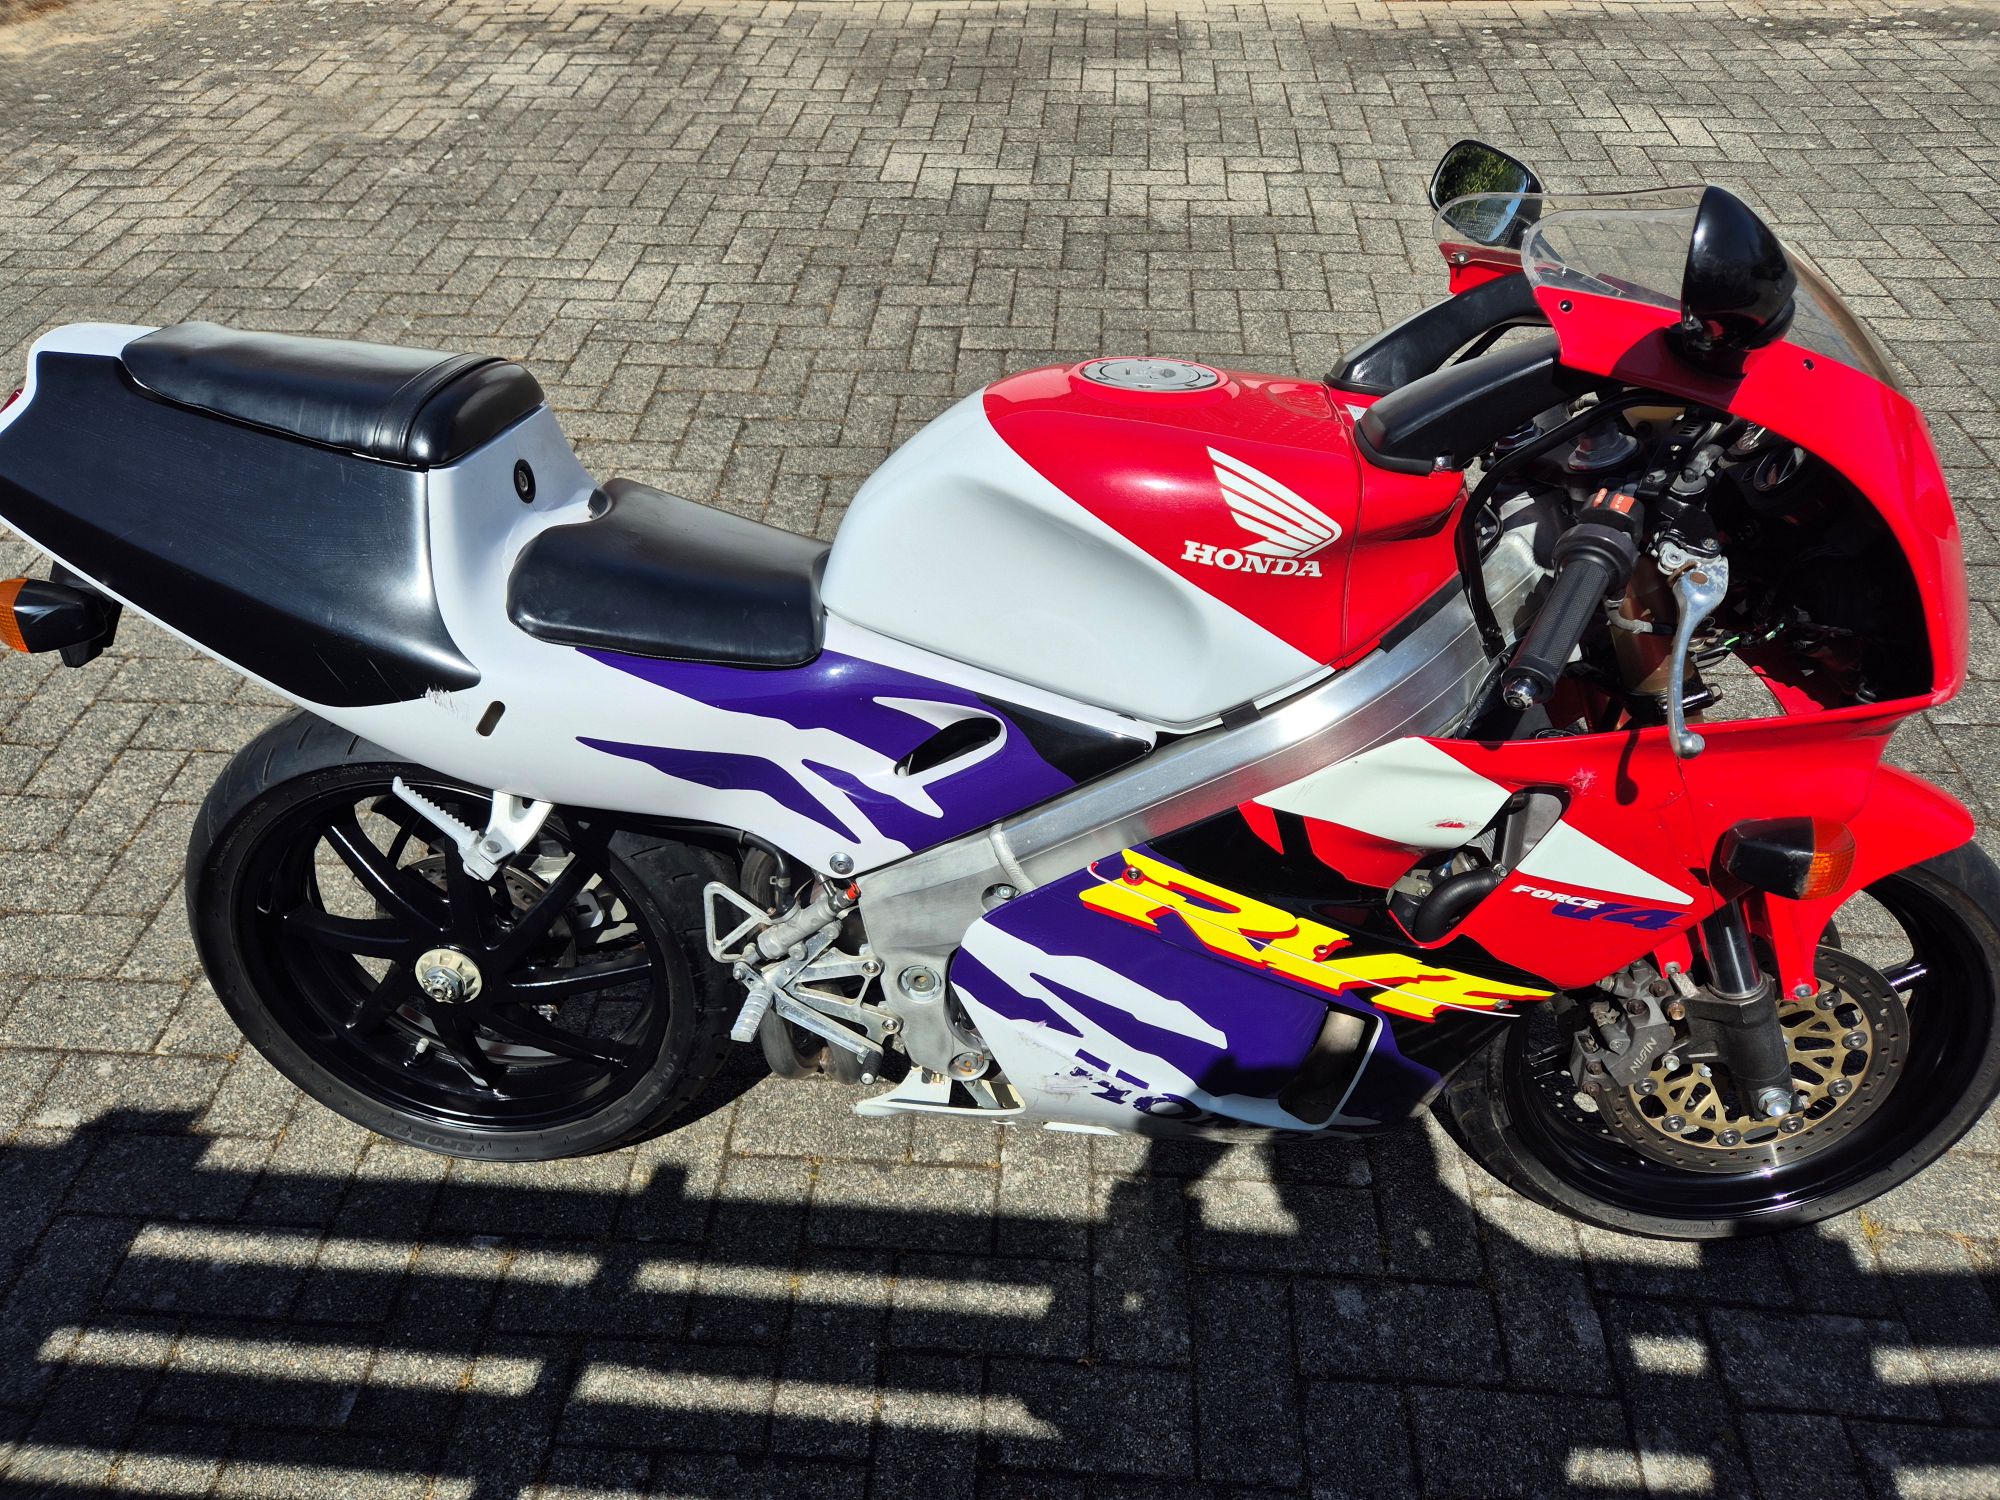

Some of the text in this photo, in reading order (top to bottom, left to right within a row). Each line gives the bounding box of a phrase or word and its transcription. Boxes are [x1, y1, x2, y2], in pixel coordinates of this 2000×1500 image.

[1181, 540, 1322, 577] HONDA
[1511, 884, 1605, 909] FORCE
[1551, 902, 1688, 930] V4
[1078, 848, 1556, 1023] RVF
[1630, 1036, 1657, 1075] NISSIN
